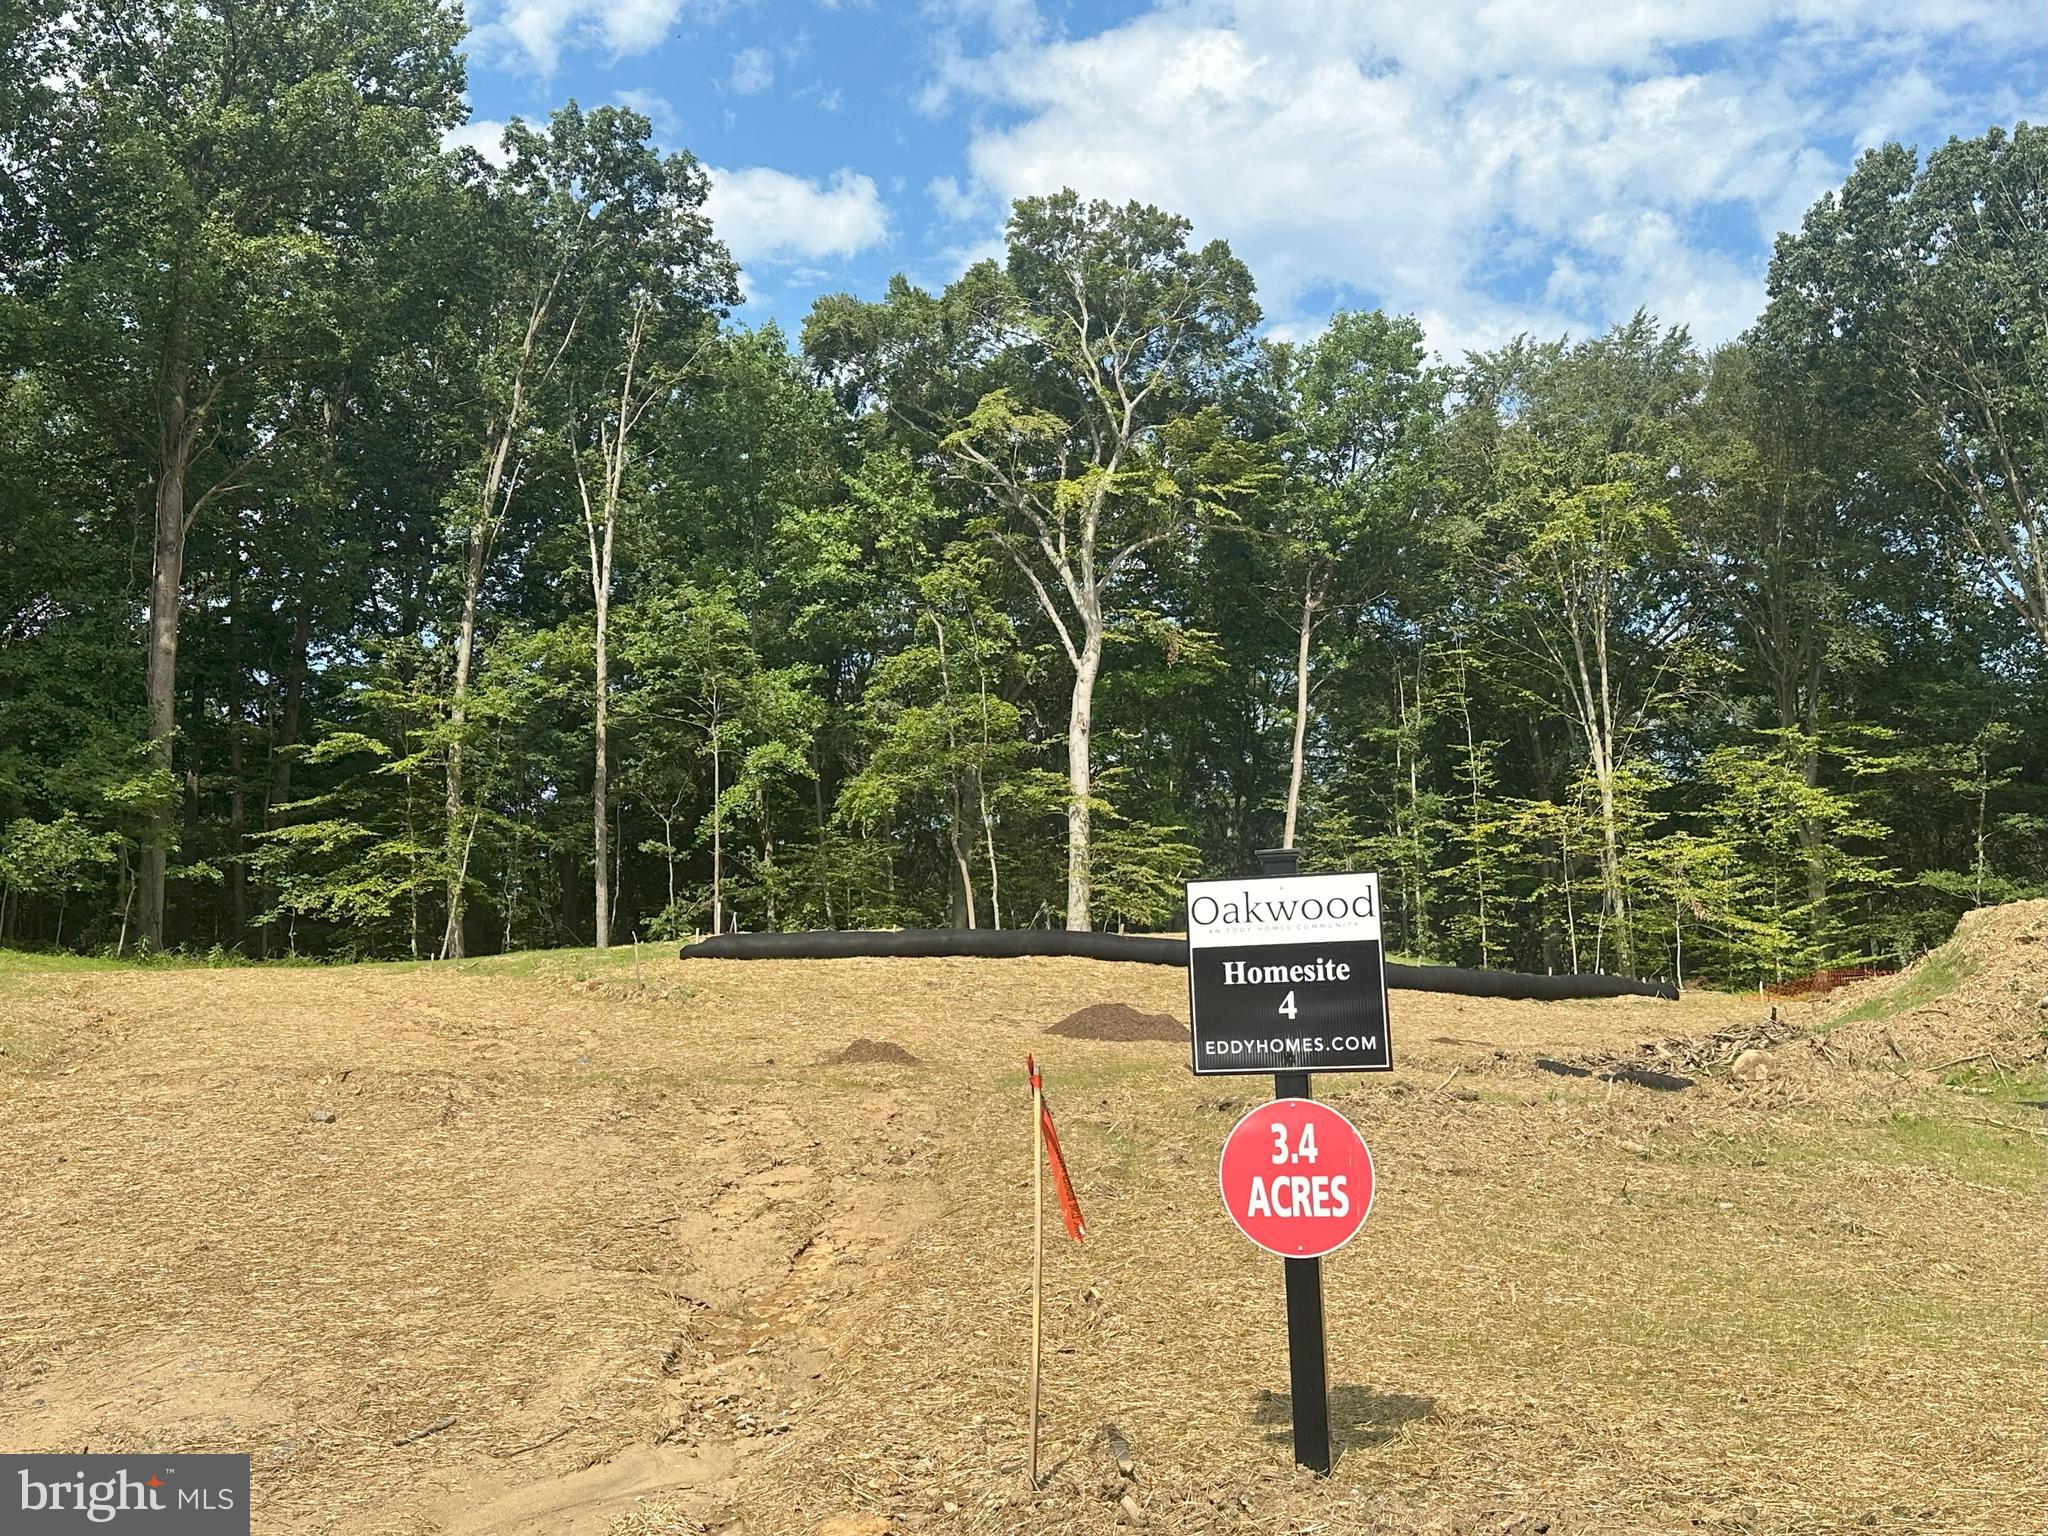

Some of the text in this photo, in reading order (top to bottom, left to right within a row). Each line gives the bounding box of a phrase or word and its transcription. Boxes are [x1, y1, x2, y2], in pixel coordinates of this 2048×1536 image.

[1191, 885, 1376, 925] Oakwood
[1297, 922, 1359, 930] COMMUNITY
[1222, 957, 1351, 985] Homesite
[1278, 990, 1298, 1020] 4
[1205, 1036, 1377, 1055] EDDYHOMES.COM
[1270, 1122, 1319, 1165] 3.4
[1247, 1175, 1350, 1218] ACRES
